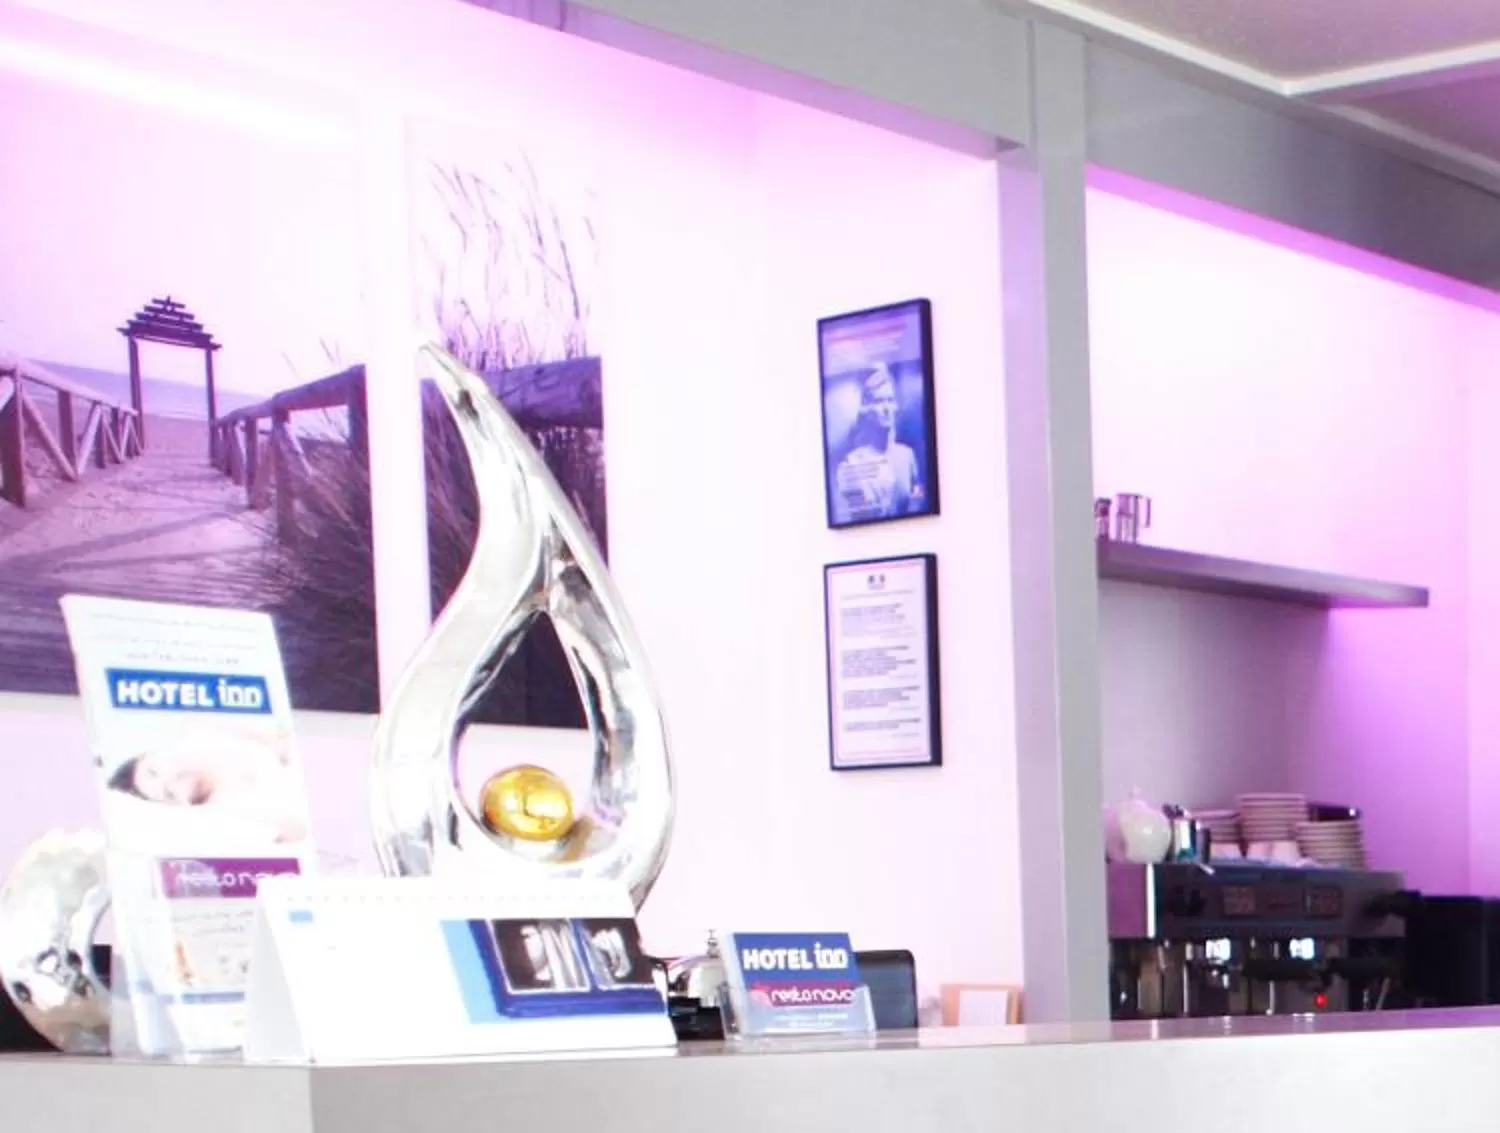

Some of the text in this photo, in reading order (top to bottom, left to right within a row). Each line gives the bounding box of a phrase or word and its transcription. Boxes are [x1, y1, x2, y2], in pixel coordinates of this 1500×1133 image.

[116, 675, 263, 708] HOTEL inn
[742, 948, 814, 971] HOTEL
